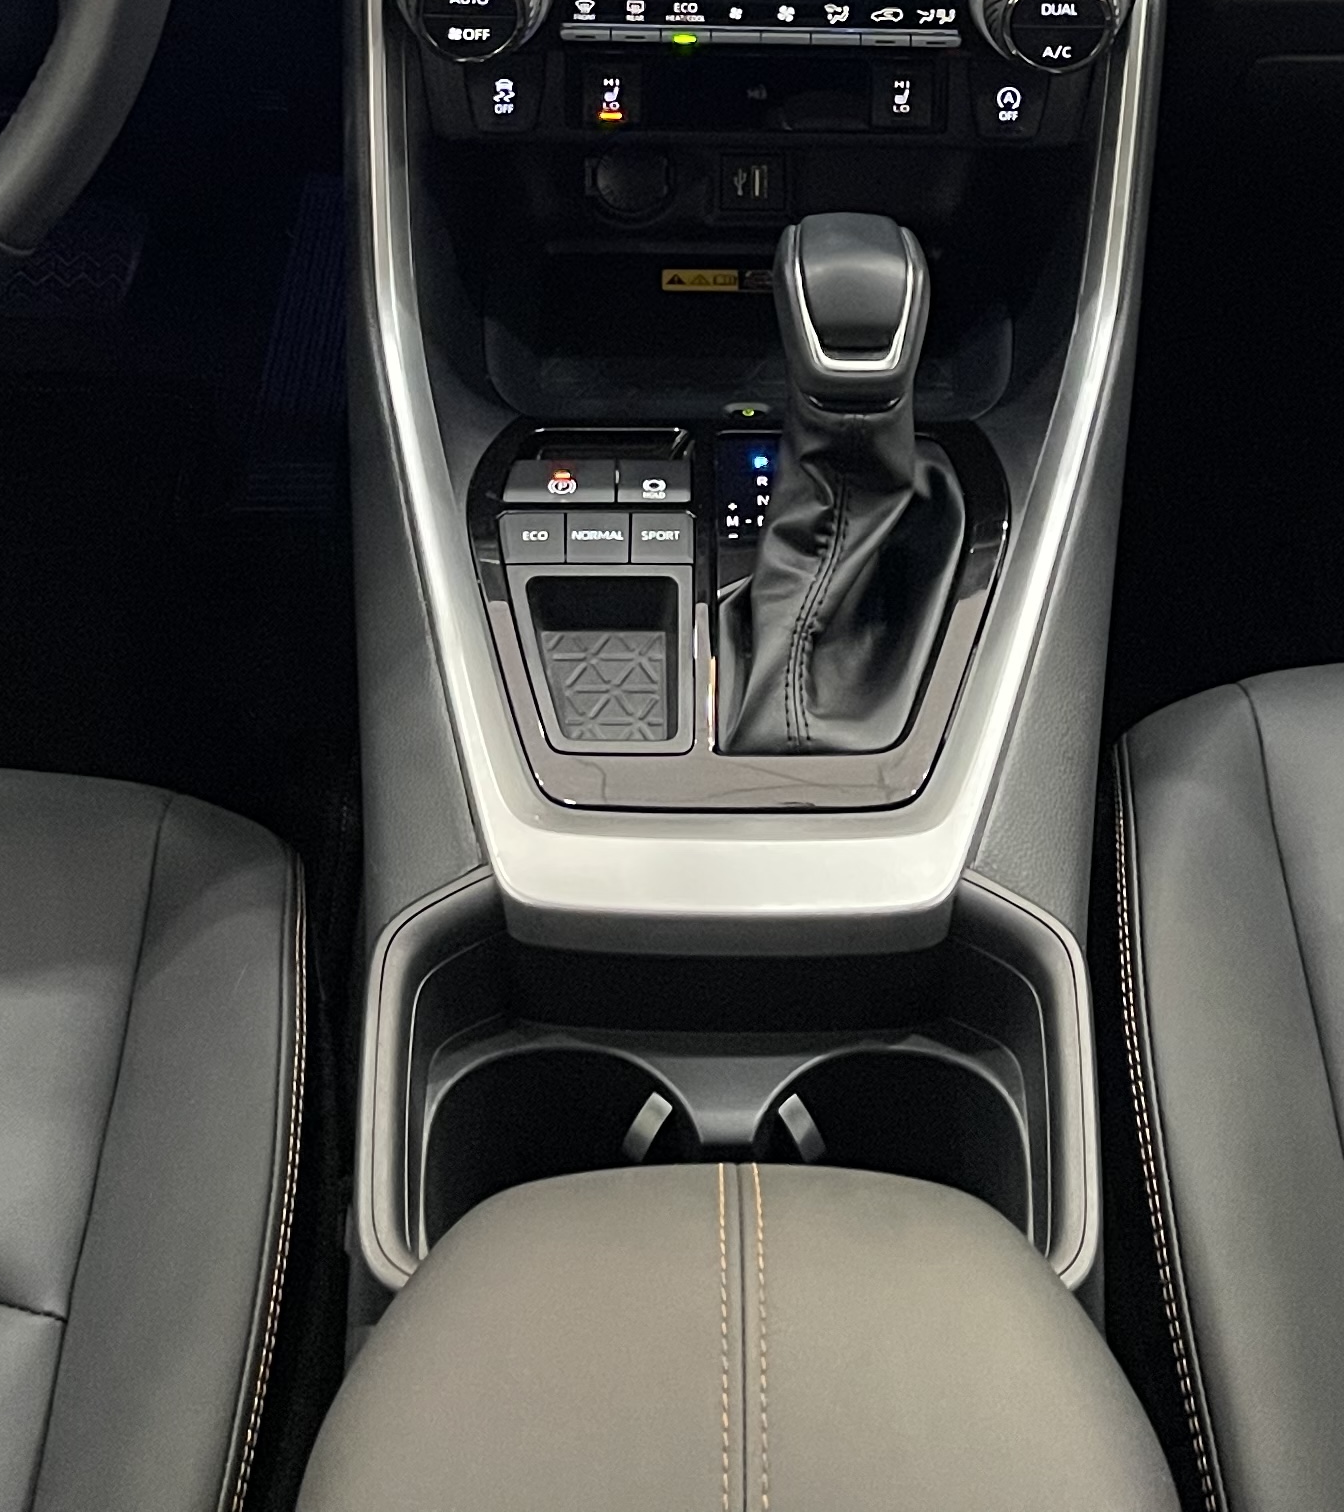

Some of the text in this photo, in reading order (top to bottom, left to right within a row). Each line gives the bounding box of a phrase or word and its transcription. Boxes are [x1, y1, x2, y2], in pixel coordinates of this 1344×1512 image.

[673, 2, 698, 13] ECO
[1041, 3, 1078, 16] DUAL
[462, 28, 491, 41] OFF
[1042, 46, 1072, 59] A/C
[603, 78, 620, 87] HI
[894, 80, 911, 89] HI
[494, 103, 514, 115] OFF
[602, 101, 620, 111] LO
[893, 104, 911, 113] LO
[998, 110, 1019, 122] OFF
[756, 475, 769, 487] R
[757, 495, 770, 506] N
[726, 515, 739, 527] M
[522, 530, 549, 541] ECO
[571, 530, 624, 541] NORMAL
[641, 530, 680, 541] SPORT
